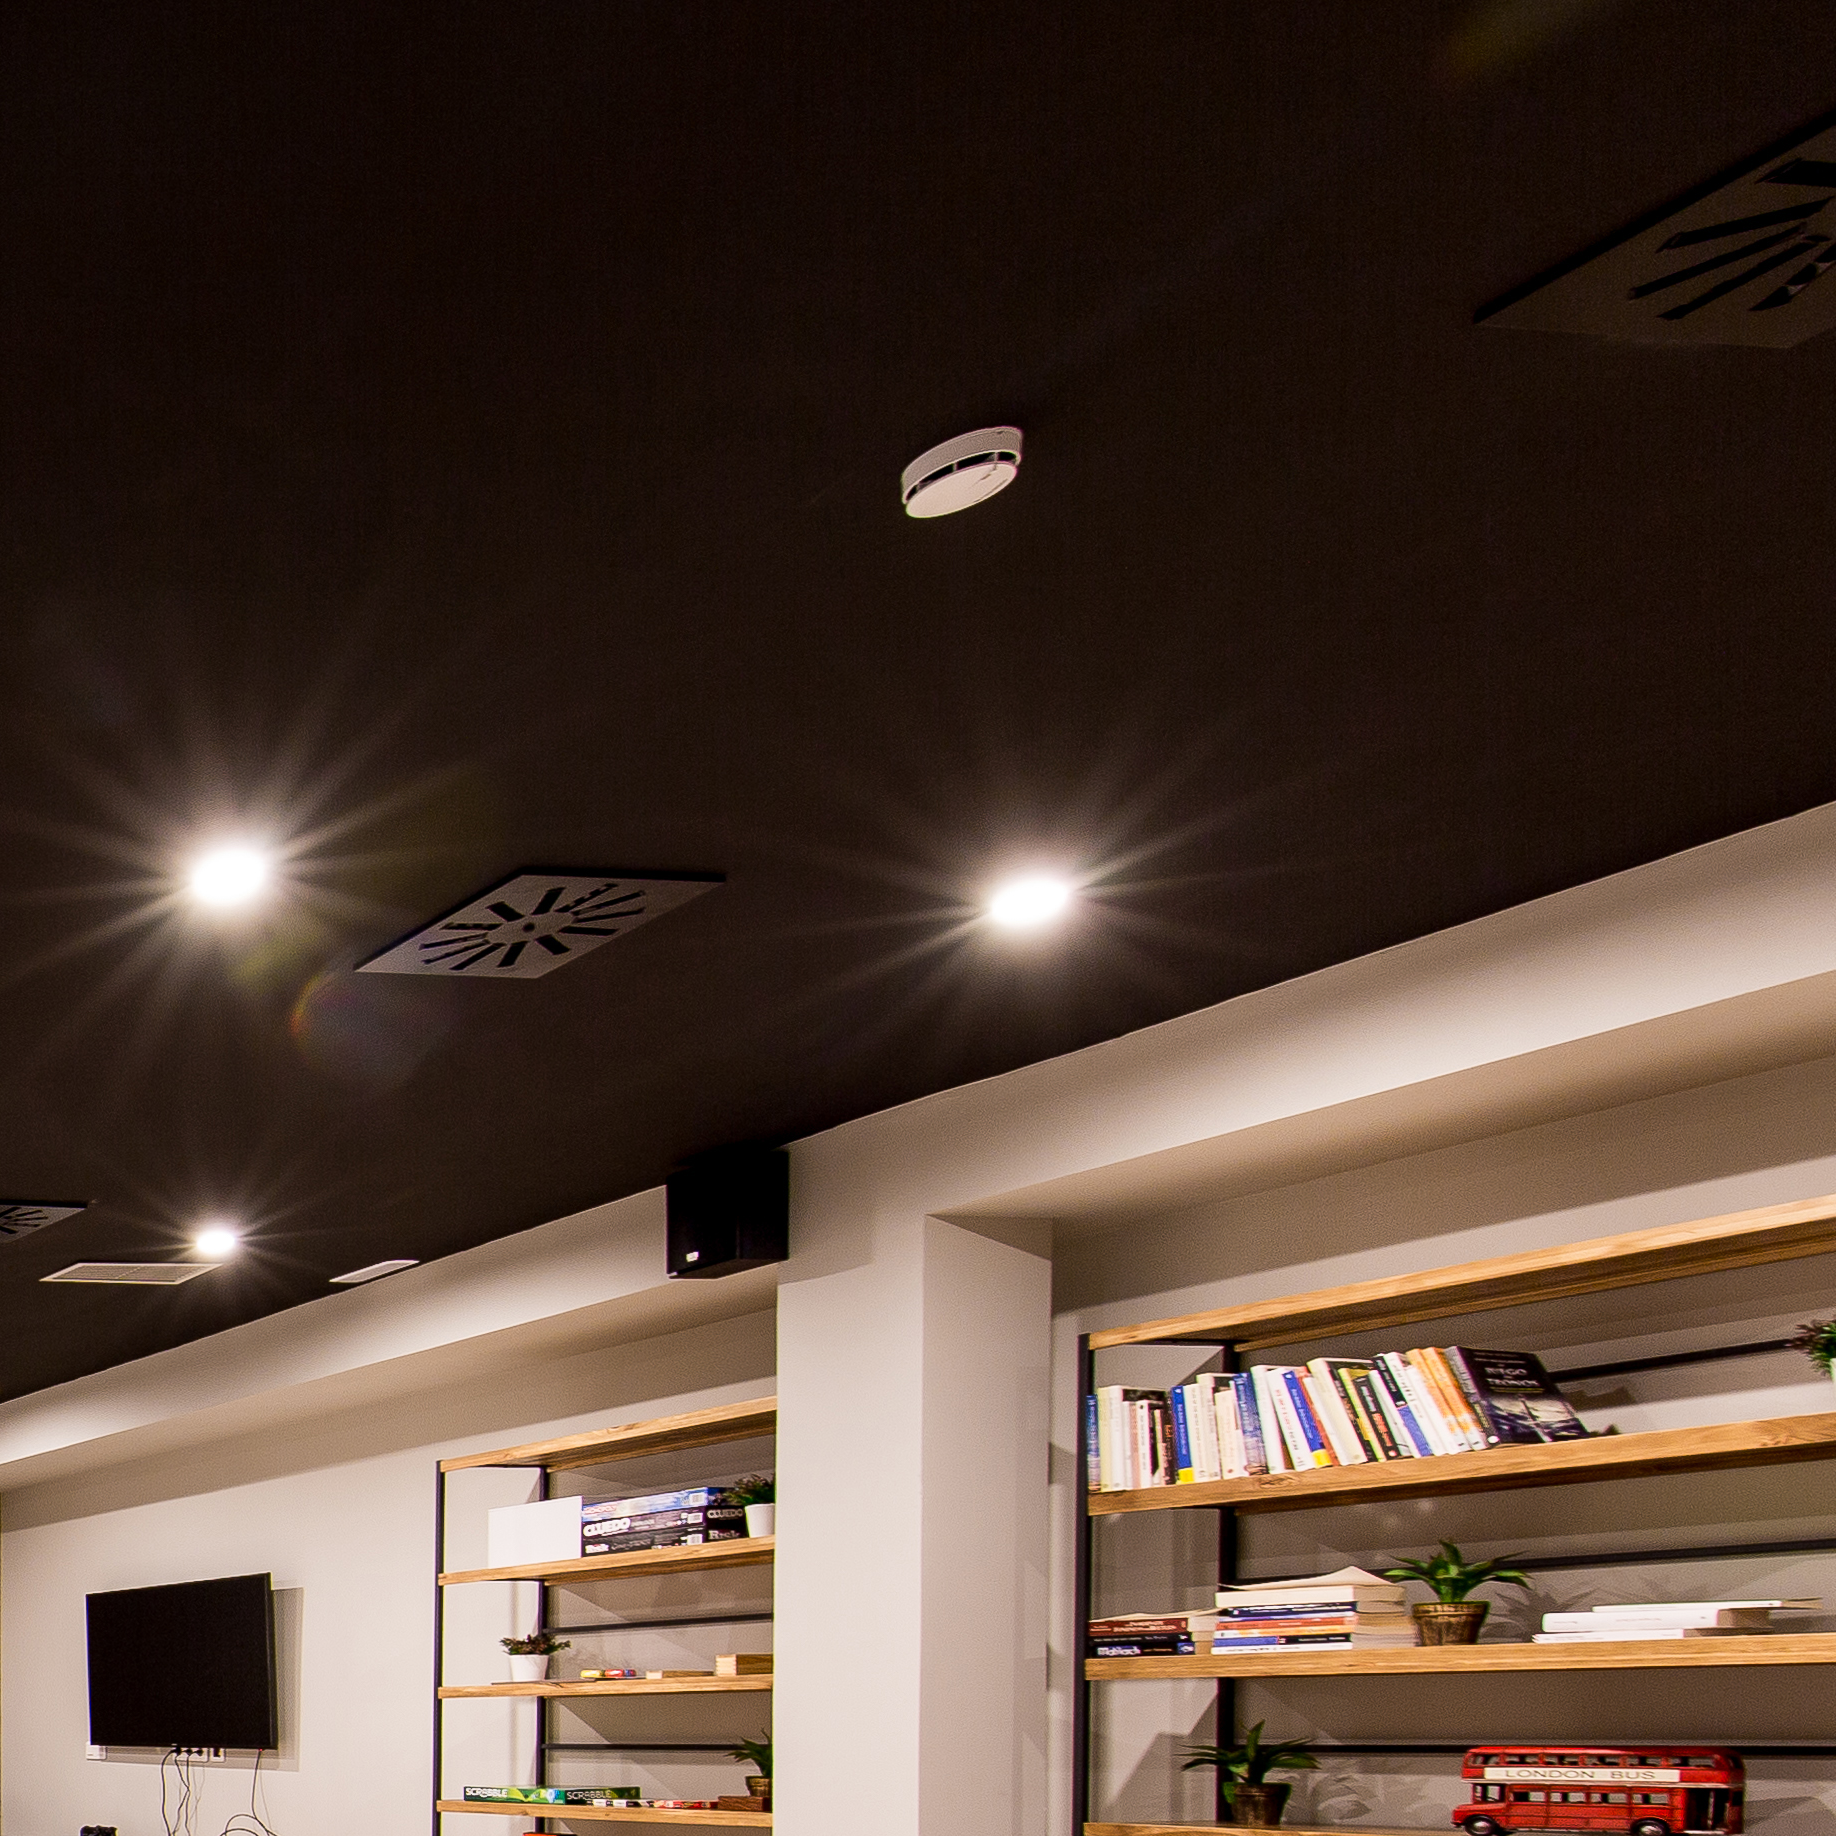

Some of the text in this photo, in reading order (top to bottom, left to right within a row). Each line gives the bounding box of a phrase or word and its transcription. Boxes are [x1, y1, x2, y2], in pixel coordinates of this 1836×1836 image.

[1505, 1768, 1656, 1780] LONDON BUS
[465, 1788, 508, 1798] SCRABBLE
[567, 1790, 612, 1800] SCRABBLE
